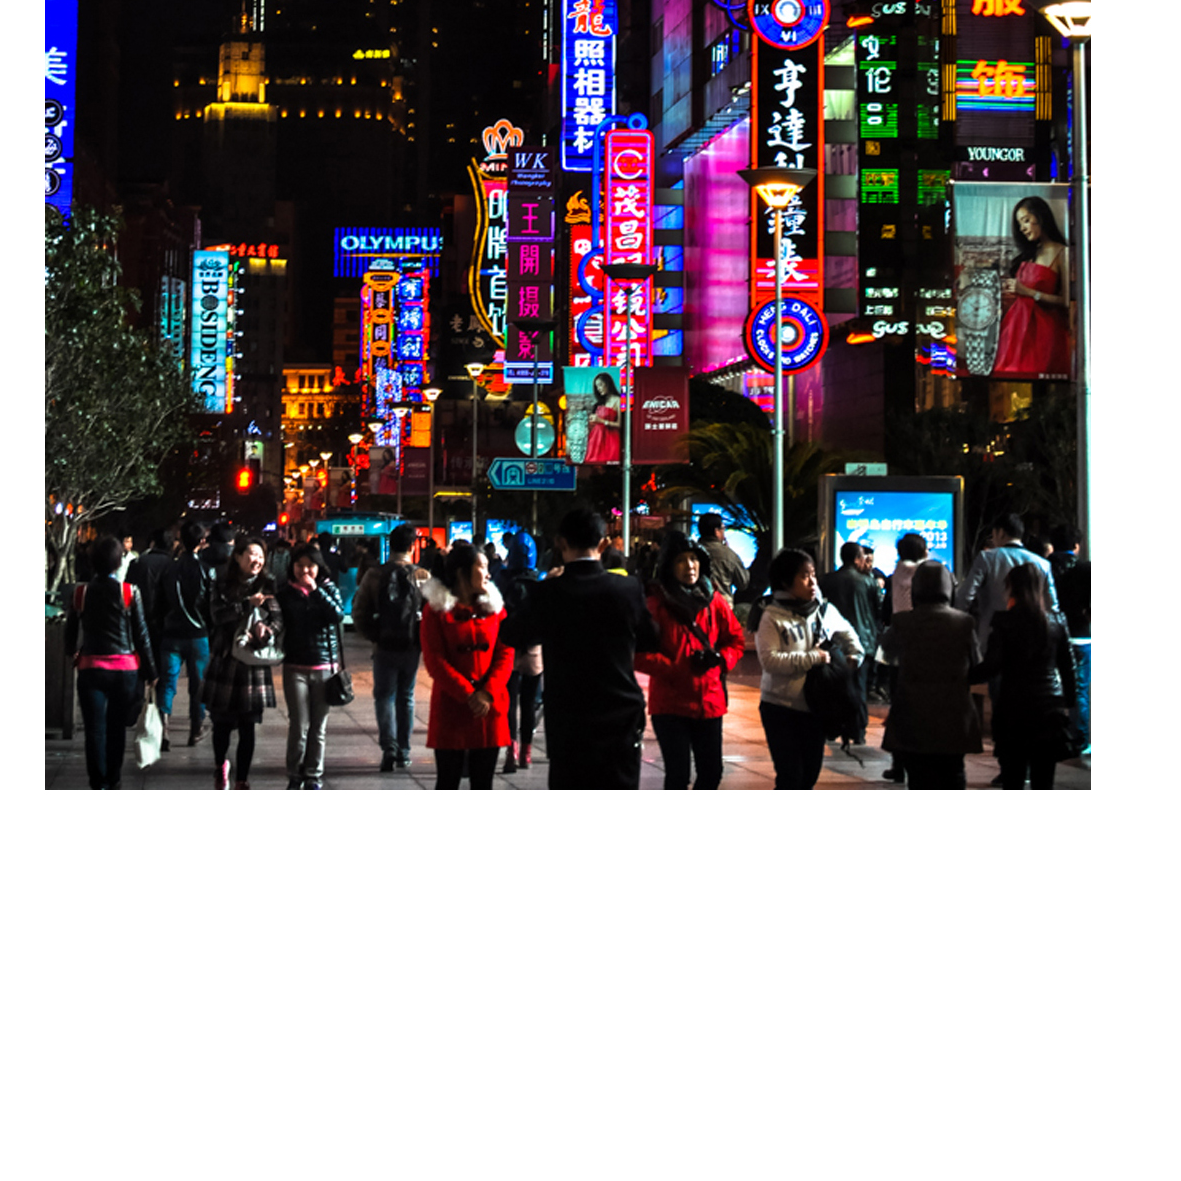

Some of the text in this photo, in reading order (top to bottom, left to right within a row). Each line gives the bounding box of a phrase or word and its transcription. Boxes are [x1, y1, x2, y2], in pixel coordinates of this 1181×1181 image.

[754, 3, 822, 15] IX III
[781, 30, 797, 42] VI
[514, 152, 549, 169] WK
[967, 147, 1025, 162] YOUNGOR
[791, 302, 818, 326] DALI
[199, 279, 219, 396] BOSIDENG
